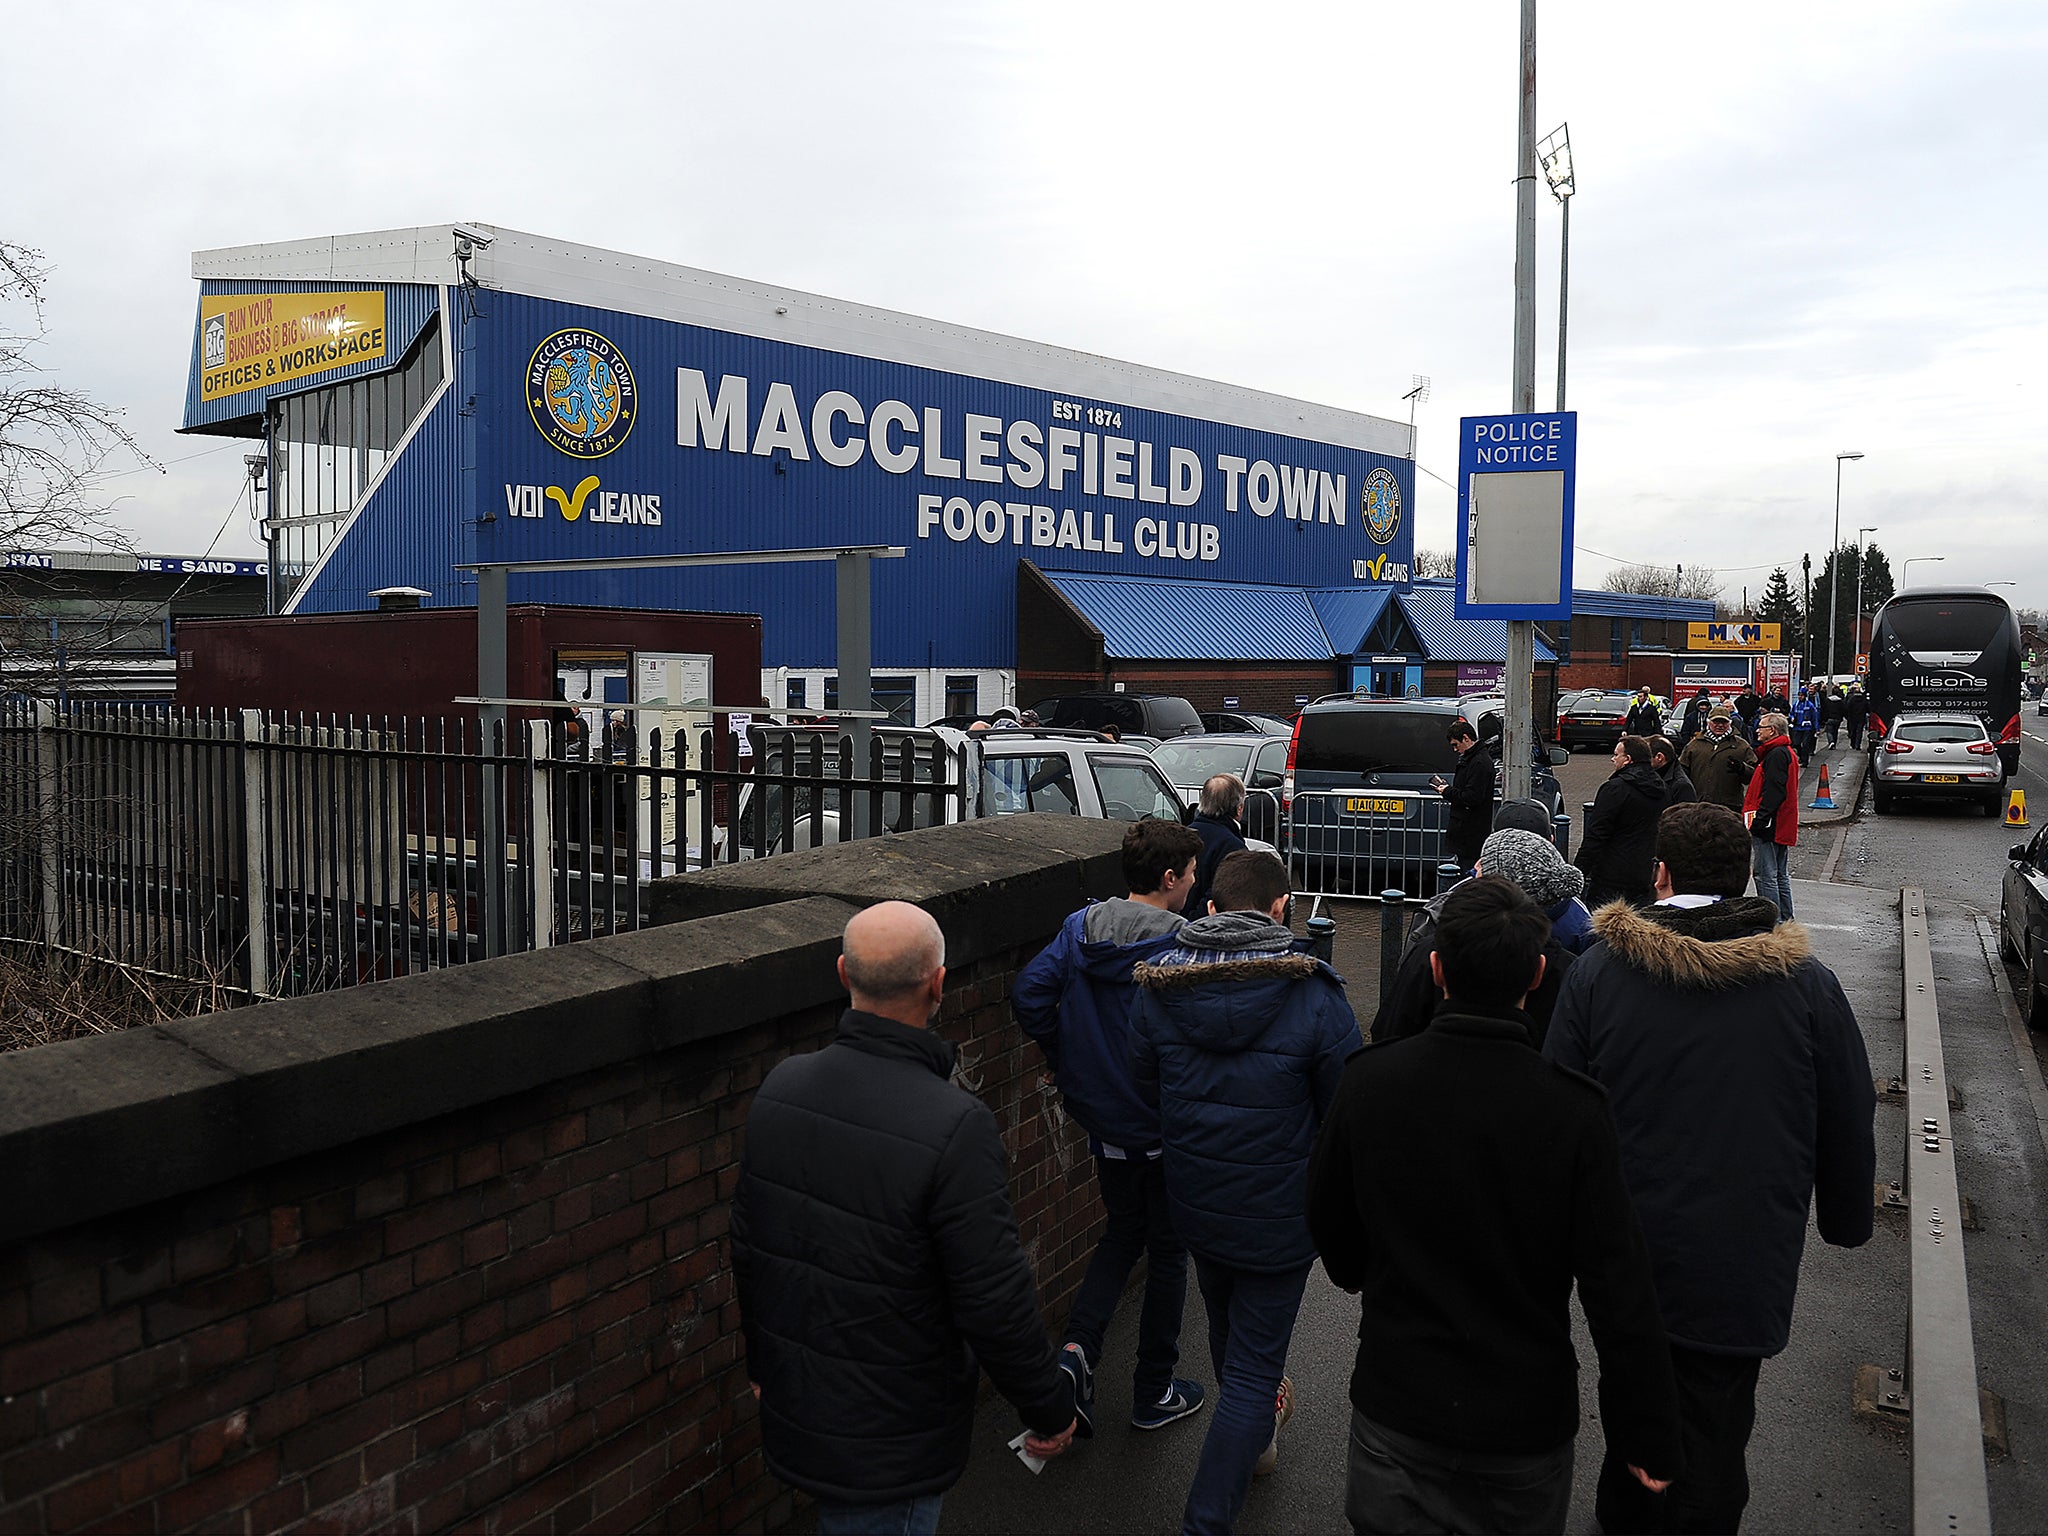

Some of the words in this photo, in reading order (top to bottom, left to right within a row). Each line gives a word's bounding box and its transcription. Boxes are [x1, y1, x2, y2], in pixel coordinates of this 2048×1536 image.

[228, 309, 246, 334] RUN
[248, 298, 273, 327] YOUR
[228, 326, 271, 363] BUSINESS
[300, 303, 346, 342] STORAGE
[204, 362, 262, 394] OFFICES
[265, 358, 276, 377] &
[279, 327, 382, 374] WORKSPACE
[531, 333, 610, 386] MACCLESFIELD
[611, 353, 633, 397] TOWN
[1052, 399, 1083, 423] EST
[1086, 406, 1123, 430] 1874
[550, 427, 585, 453] SINCE
[589, 434, 616, 453] 1874
[676, 366, 1204, 507] MACCLESFIELD
[1217, 455, 1348, 527] TOWN
[1474, 420, 1562, 443] POLICE
[1476, 444, 1558, 464] NOTICE
[505, 483, 544, 518] VOI
[589, 491, 662, 526] JEANS
[1363, 470, 1392, 503] MACCLESFIELD
[1391, 480, 1400, 507] TOWN
[917, 494, 1124, 554] FOOTBALL
[1134, 516, 1221, 561] CLUB
[181, 561, 236, 575] SAND
[1353, 559, 1367, 579] VOI
[1382, 562, 1408, 582] JEANS
[1708, 623, 1761, 645] MKM
[1901, 676, 1988, 686] ellisons
